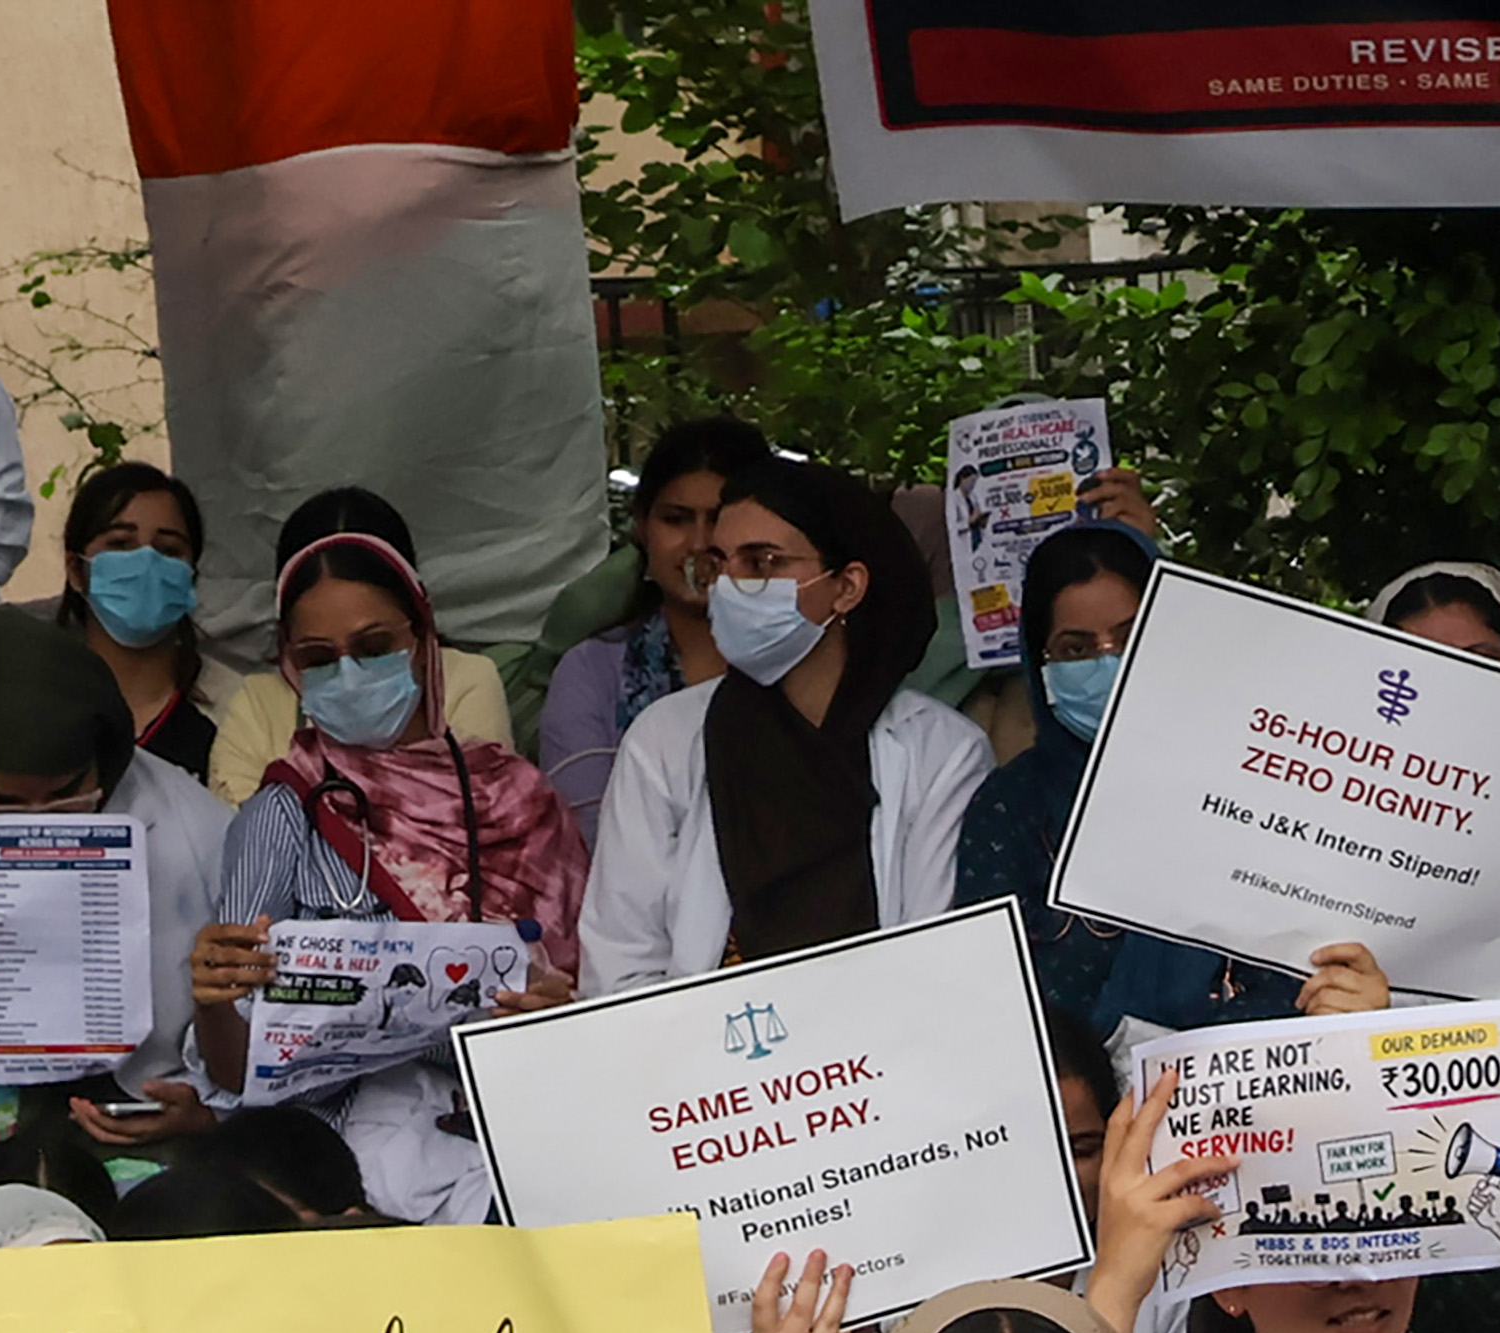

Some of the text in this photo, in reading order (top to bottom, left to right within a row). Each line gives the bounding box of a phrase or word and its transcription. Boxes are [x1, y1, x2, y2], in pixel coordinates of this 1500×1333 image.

[1208, 77, 1283, 96] SAME
[1294, 74, 1389, 92] DUTIES
[1417, 73, 1490, 91] SAME
[1242, 747, 1474, 836] ZERO DIGNITY.
[1249, 708, 1492, 799] 36-HOUR DUTY.
[1201, 793, 1481, 888] Hike J&K Intern Stipend!
[1231, 868, 1416, 931] #HikeJKInternStipend
[1382, 1029, 1487, 1053] OUR DEMAND
[648, 1056, 885, 1134] SAME WORK.
[671, 1097, 881, 1171] EQUAL PAY.
[709, 1123, 1010, 1219] National Standards, Not
[741, 1198, 852, 1243] Pennies!
